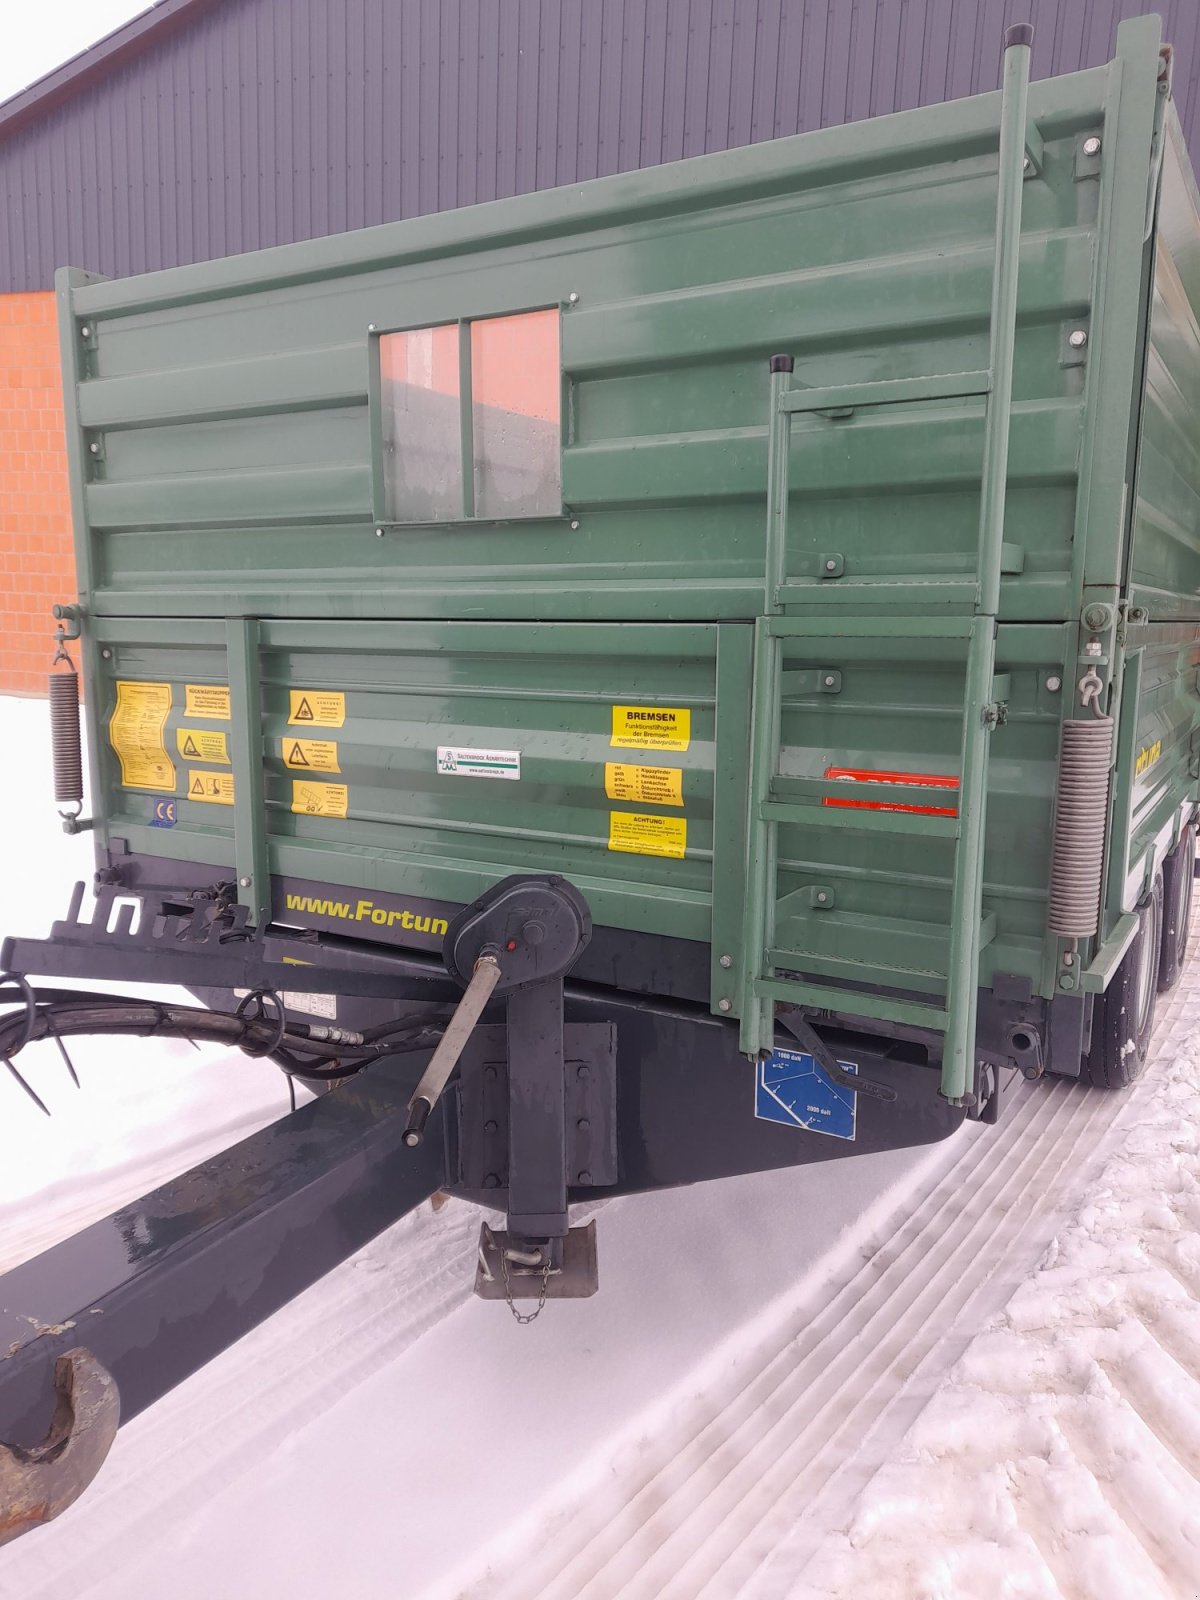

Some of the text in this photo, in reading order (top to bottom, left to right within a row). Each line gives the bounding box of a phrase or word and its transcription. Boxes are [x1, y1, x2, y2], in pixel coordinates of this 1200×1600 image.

[626, 711, 676, 722] BREMSEN
[625, 722, 678, 732] Funktionsfähigkeit
[616, 737, 649, 745] regelmäßig
[633, 816, 666, 825] ACHTUNG!
